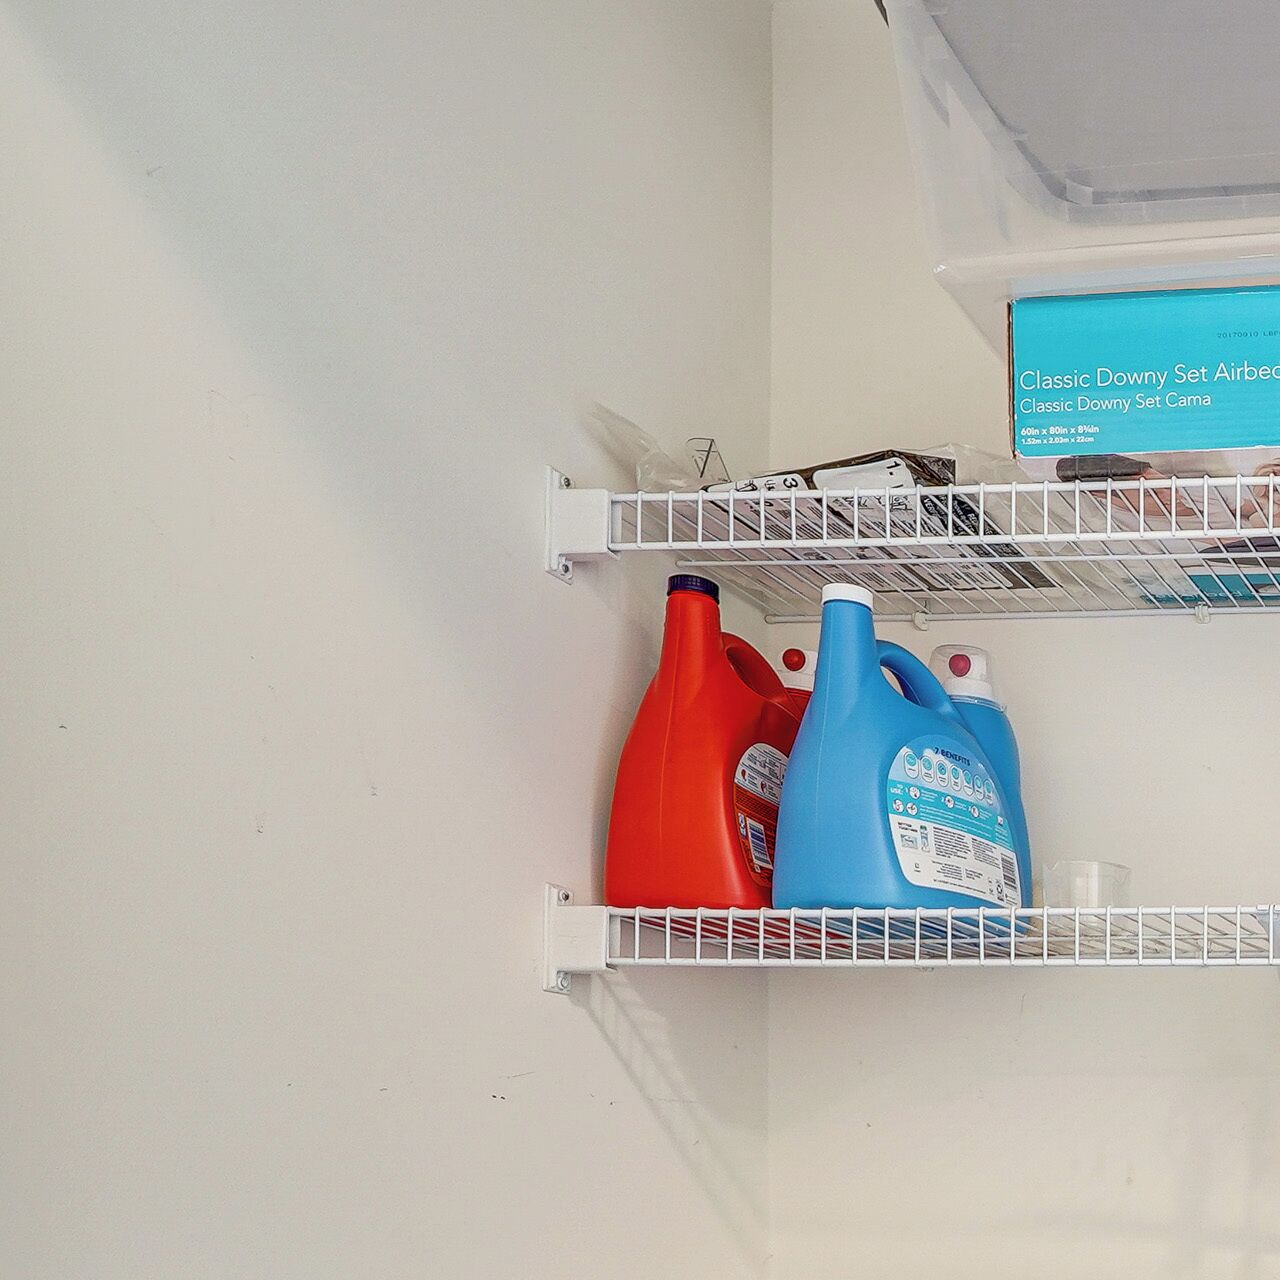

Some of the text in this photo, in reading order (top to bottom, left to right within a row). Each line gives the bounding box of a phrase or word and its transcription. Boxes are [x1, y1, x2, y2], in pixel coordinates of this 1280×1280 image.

[1020, 370, 1090, 389] Classic
[1097, 367, 1168, 390] Downy
[1174, 363, 1207, 383] Set
[1020, 392, 1211, 414] Classic Downy Set Cama
[1021, 427, 1039, 435] 60in
[1049, 426, 1068, 435] 80in
[940, 749, 970, 766] BENEFITS
